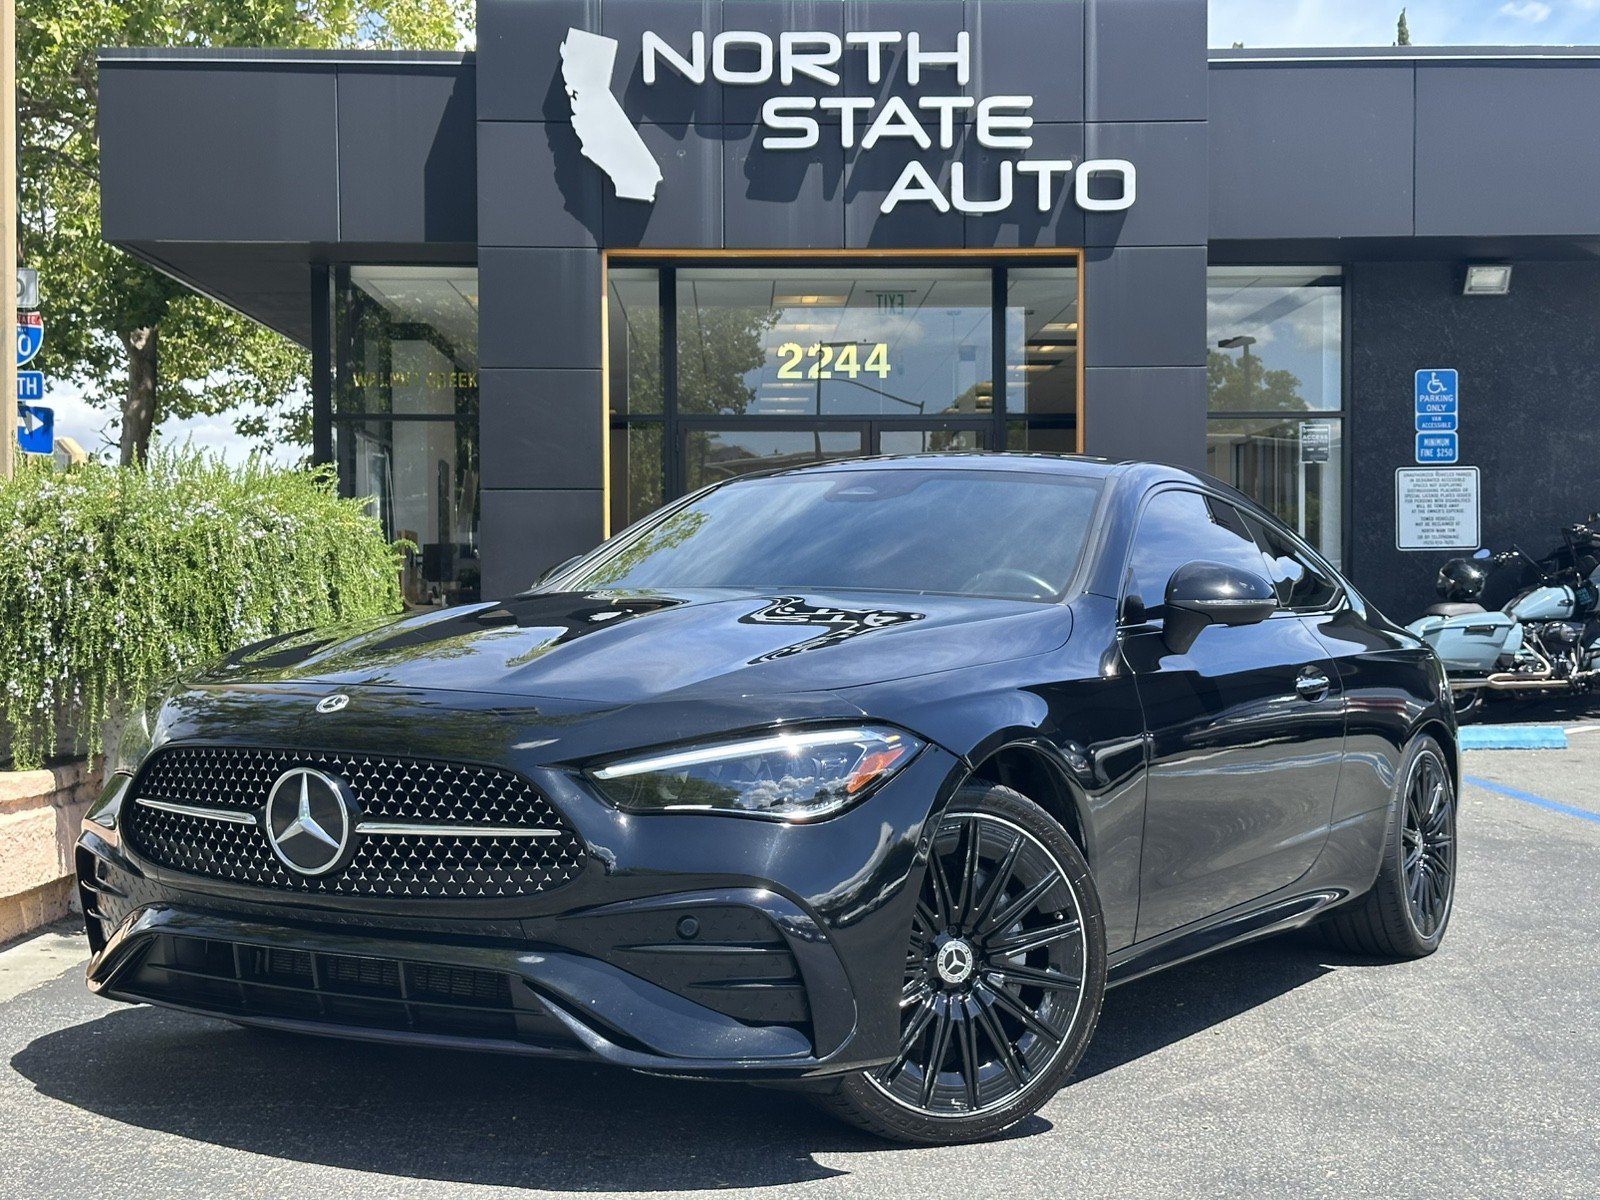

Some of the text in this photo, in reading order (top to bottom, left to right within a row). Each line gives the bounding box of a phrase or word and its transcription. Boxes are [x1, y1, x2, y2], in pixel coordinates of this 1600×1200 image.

[642, 30, 970, 87] NORTH
[761, 95, 1034, 151] STATE
[880, 159, 1137, 214] AUTO
[776, 342, 892, 380] 2244
[1420, 448, 1453, 457] FINE $250
[1424, 438, 1450, 446] MINIMUM
